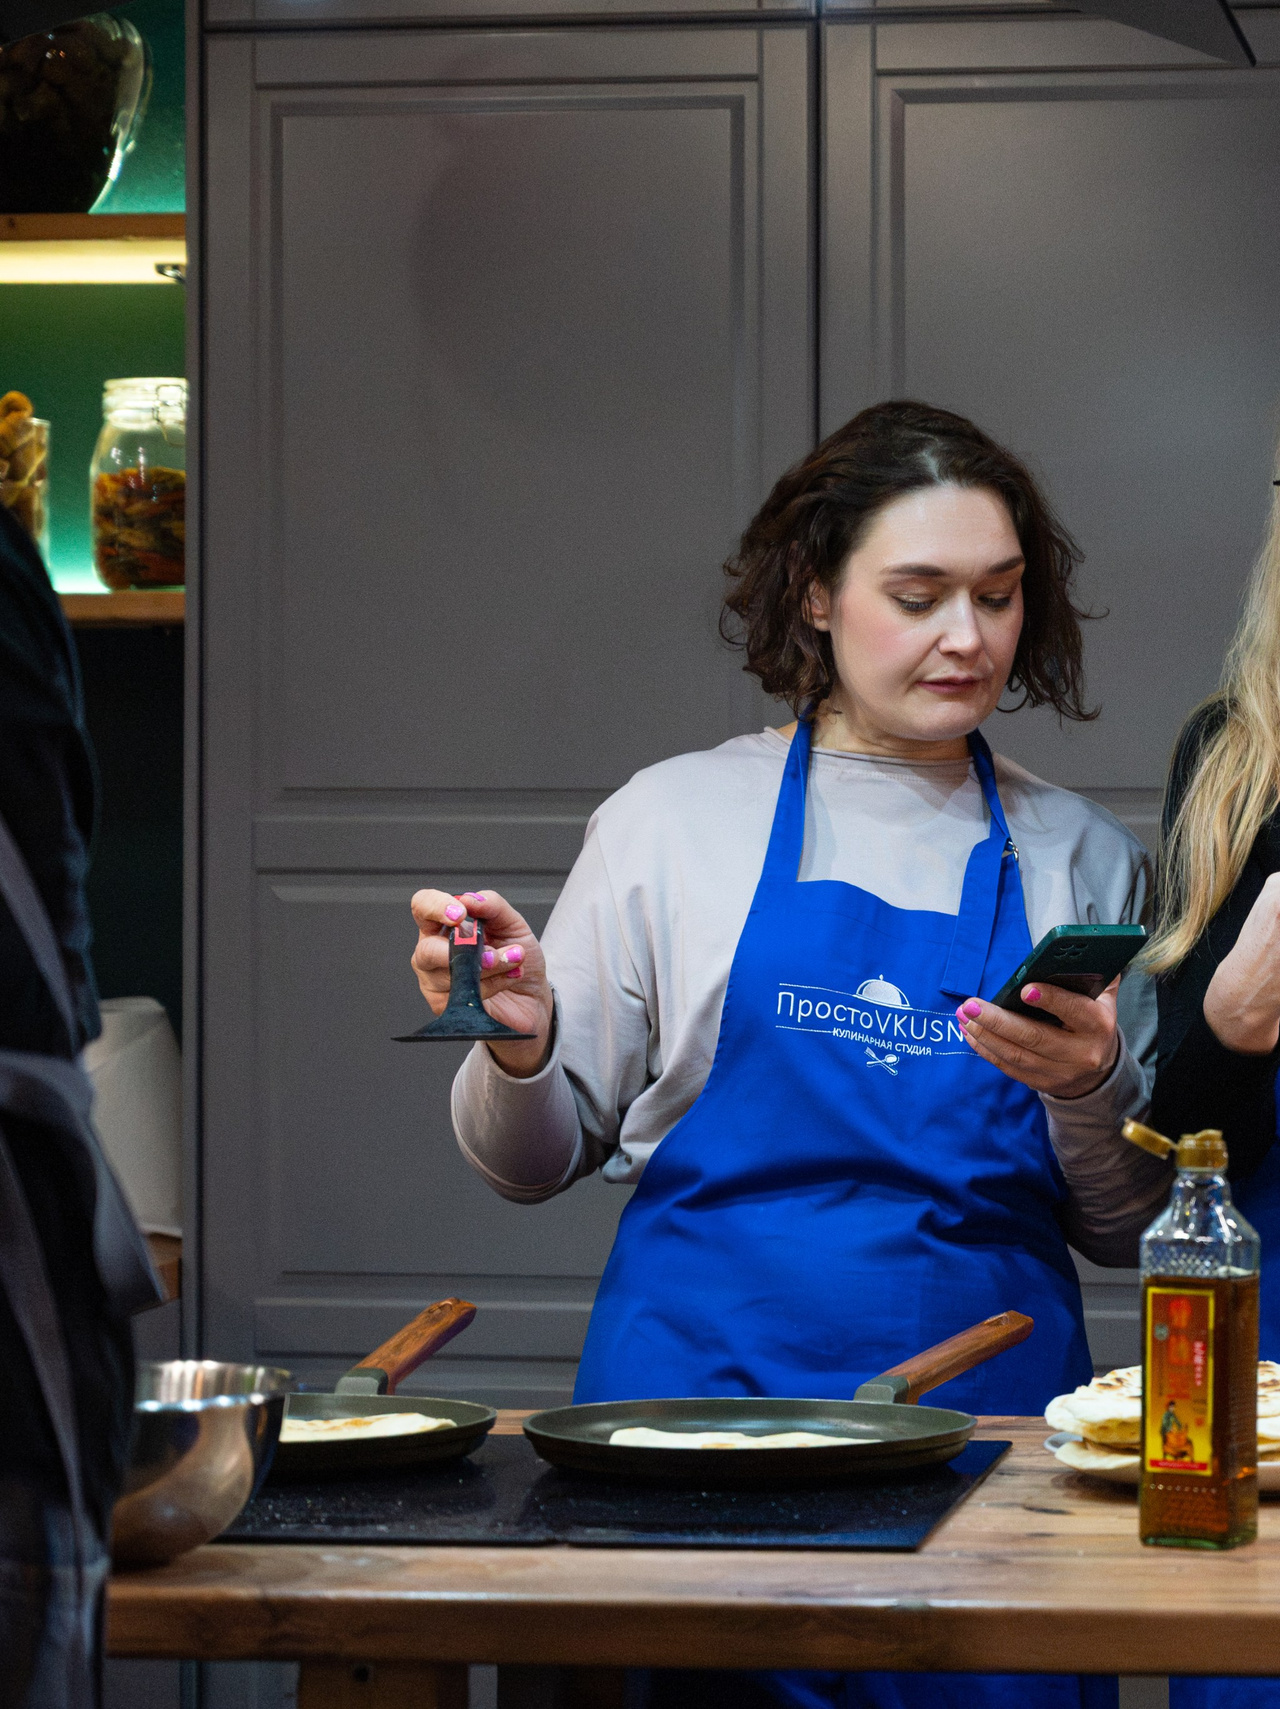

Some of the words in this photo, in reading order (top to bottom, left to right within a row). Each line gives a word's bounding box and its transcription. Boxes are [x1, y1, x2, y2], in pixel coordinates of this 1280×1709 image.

[777, 991, 964, 1043] ПростоVKUSN
[832, 1027, 893, 1049] КУЛИНАРНАЯ
[894, 1042, 932, 1056] СТУДИЯ
